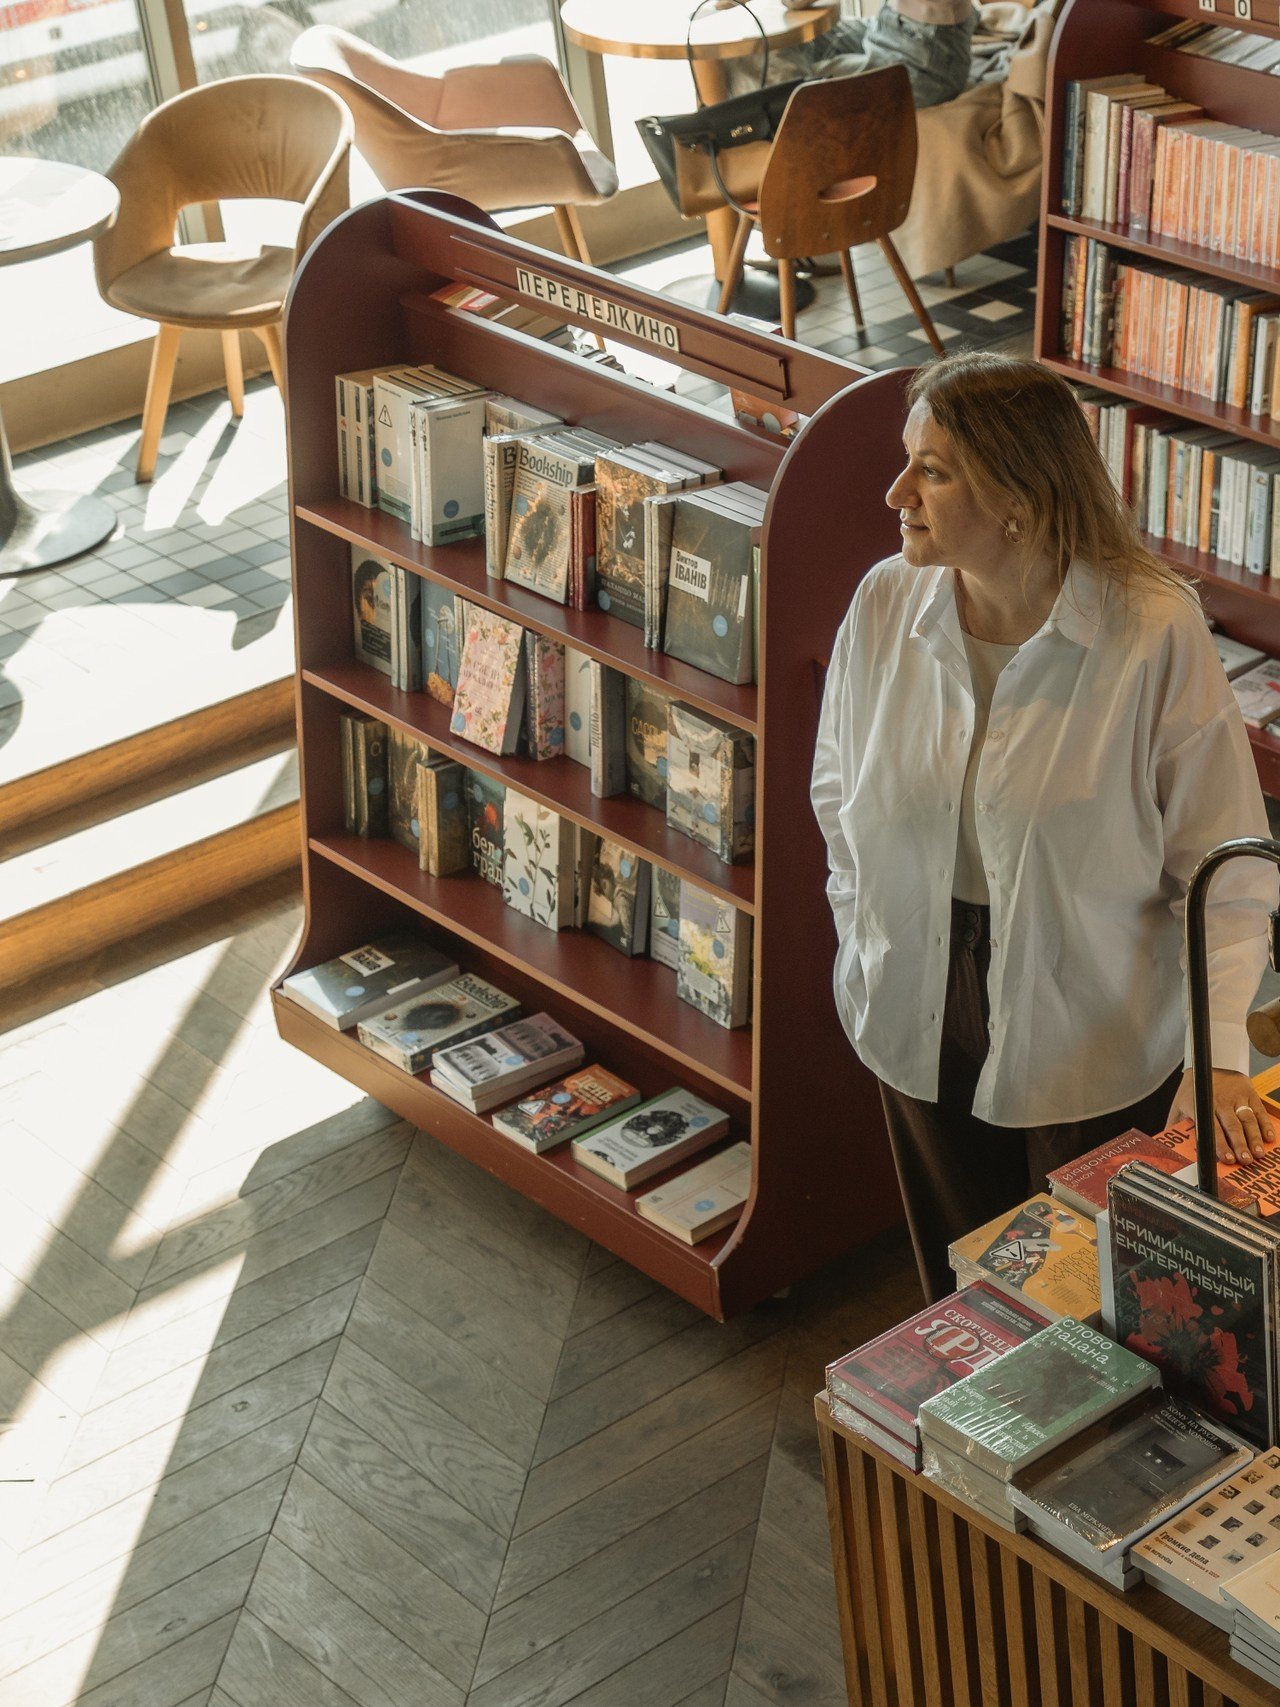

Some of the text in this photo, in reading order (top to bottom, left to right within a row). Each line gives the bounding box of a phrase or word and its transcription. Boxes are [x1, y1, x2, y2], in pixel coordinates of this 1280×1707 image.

[519, 270, 675, 348] ПЕРЕДЕЛКИНО
[518, 446, 574, 489] Bookship
[674, 561, 707, 591] ІВАНІВ
[675, 548, 700, 568] Виктор
[472, 852, 504, 887] град
[572, 1071, 612, 1107] День
[1058, 1134, 1142, 1185] МАЛИНОВЫЙ
[1114, 1214, 1256, 1297] КРИМИНАЛЬНЫЙ
[1115, 1231, 1245, 1305] ЕКАТЕРИНБУРГ
[914, 1318, 1001, 1373] ЯРД
[1049, 1325, 1109, 1366] пацана
[1061, 1317, 1113, 1351] СЛОВО
[1135, 1360, 1152, 1373] 18+
[1160, 1409, 1222, 1452] СИДЕТЬ ХОРОШО?
[1166, 1404, 1189, 1422] КОМУ
[1197, 1424, 1218, 1443] РУСИ
[1158, 1529, 1211, 1567] Громкие дела
